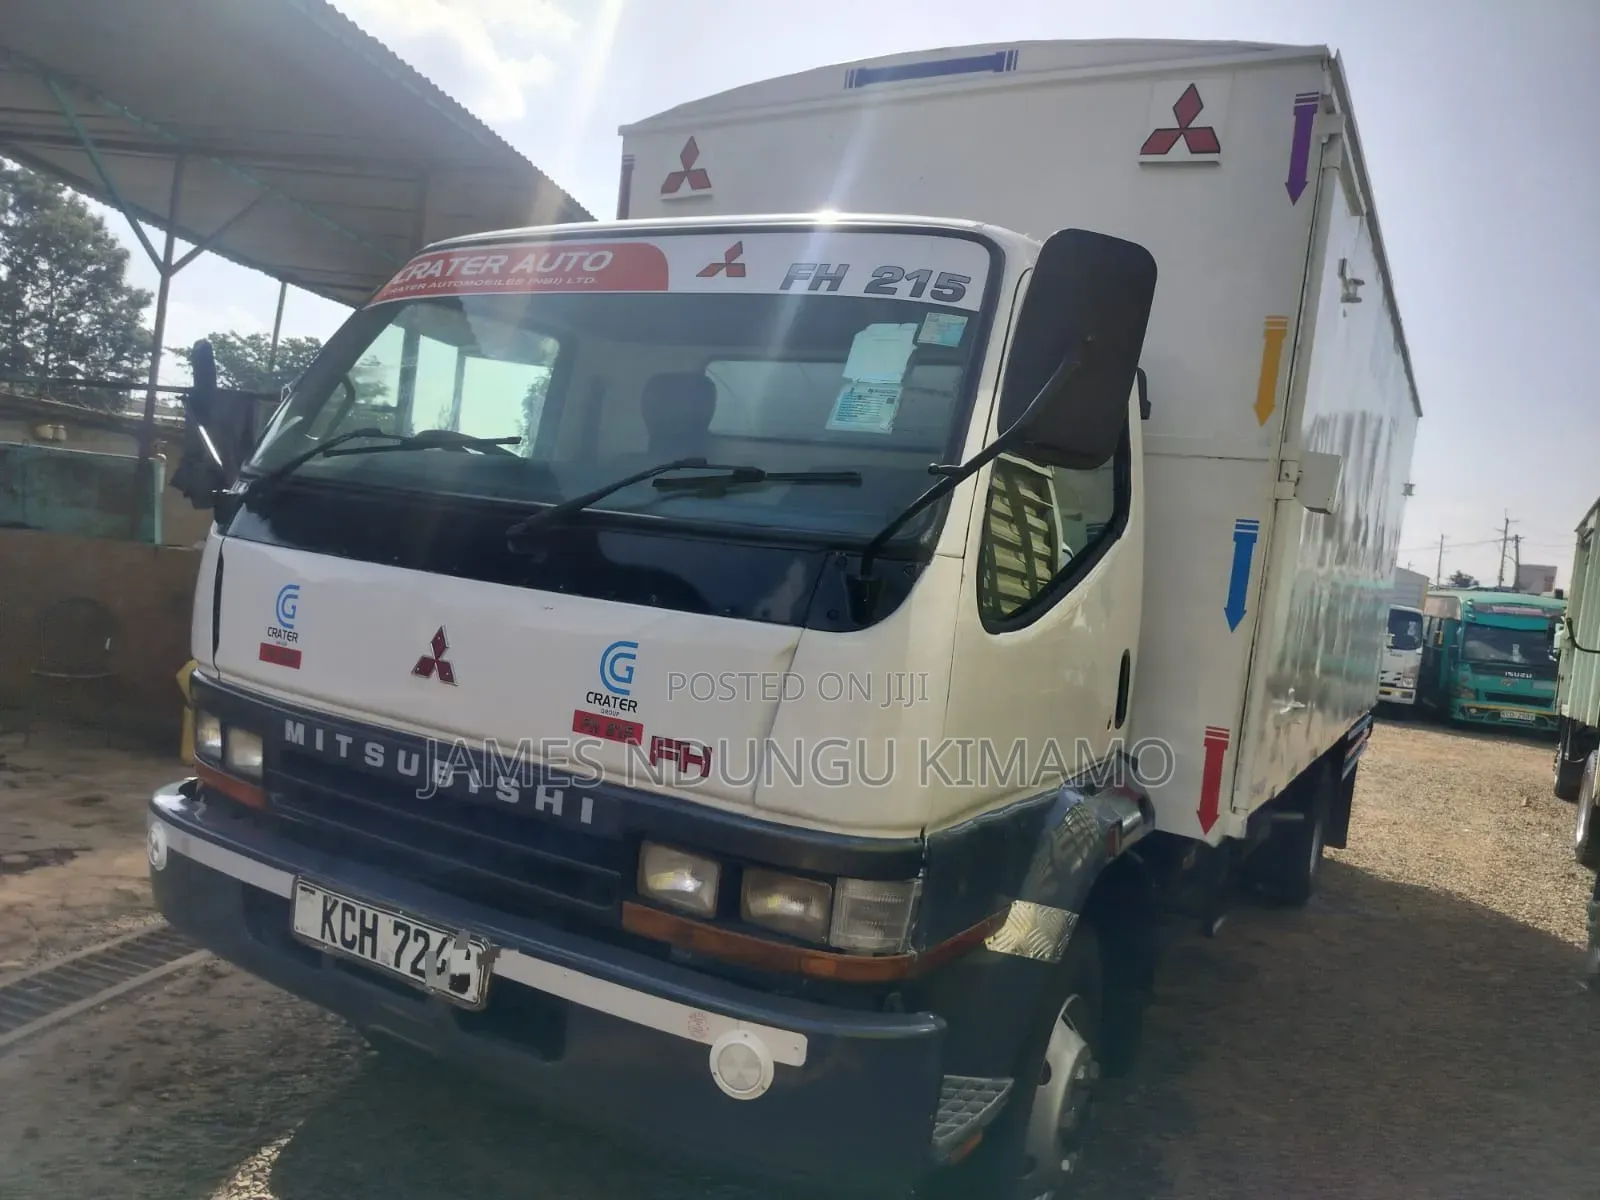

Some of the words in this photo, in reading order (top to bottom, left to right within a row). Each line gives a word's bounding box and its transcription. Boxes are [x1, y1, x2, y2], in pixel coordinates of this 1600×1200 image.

[509, 250, 613, 274] AUTO
[779, 263, 850, 292] FH
[864, 265, 972, 302] 215
[267, 626, 299, 643] CRATER
[1504, 671, 1533, 679] ISUZU
[586, 691, 638, 713] CRATER
[601, 708, 620, 717] GROUP
[650, 735, 713, 778] FH
[284, 718, 594, 825] MITSUBISHI
[320, 894, 378, 960] KCH
